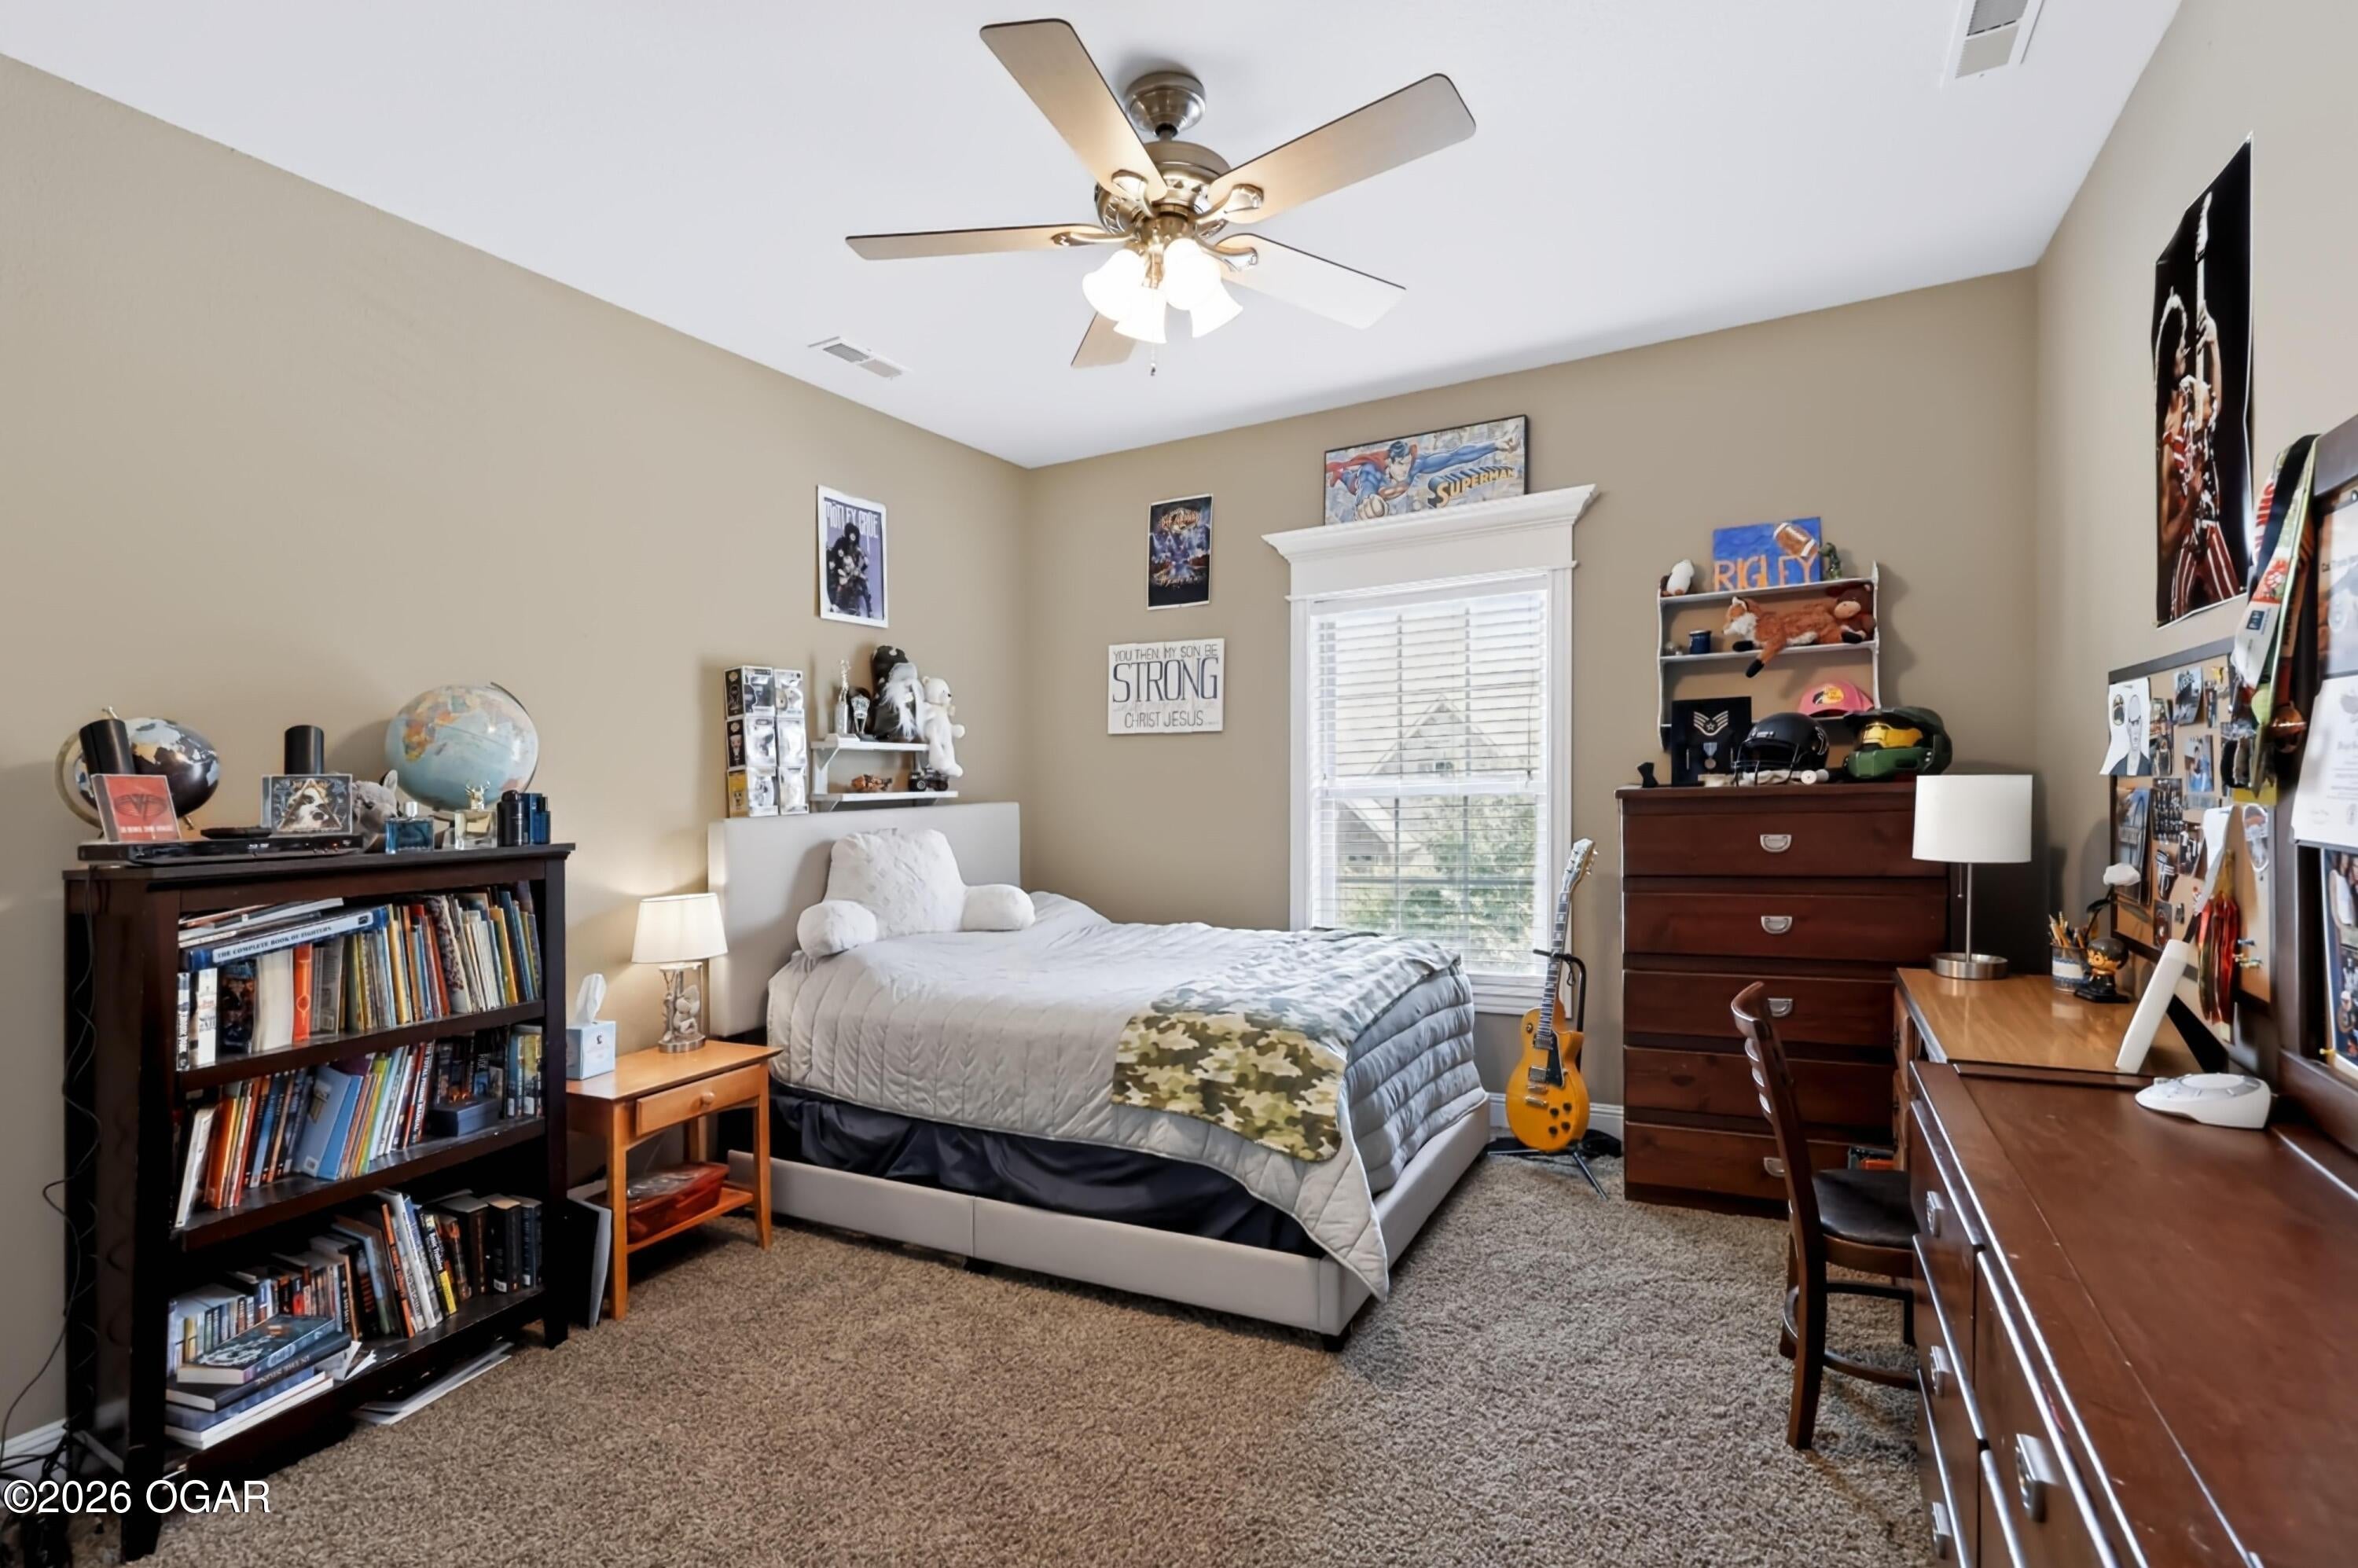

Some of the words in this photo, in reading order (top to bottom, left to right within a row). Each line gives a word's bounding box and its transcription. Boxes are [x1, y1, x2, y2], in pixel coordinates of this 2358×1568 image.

[1431, 467, 1517, 509] SUPERMAN
[1113, 650, 1133, 662] YOU
[1164, 647, 1177, 659] MY
[1204, 644, 1218, 656] BE
[1112, 656, 1219, 703] STRONG
[1124, 711, 1161, 729] CHRIST
[1164, 710, 1204, 727] JESUS
[233, 942, 268, 954] COMPLETE
